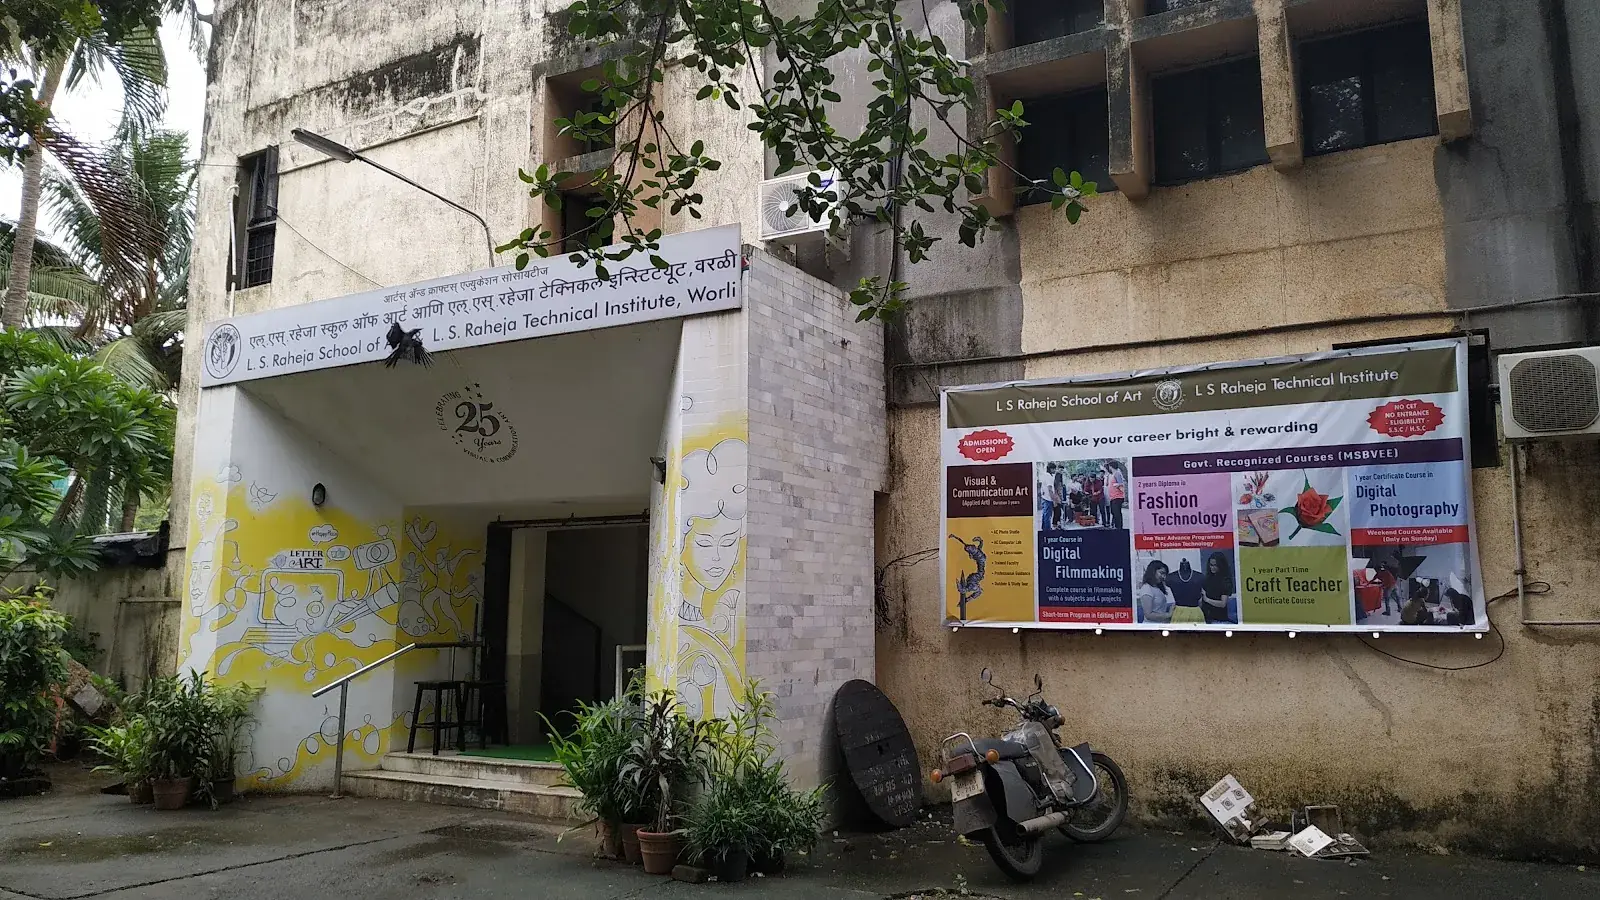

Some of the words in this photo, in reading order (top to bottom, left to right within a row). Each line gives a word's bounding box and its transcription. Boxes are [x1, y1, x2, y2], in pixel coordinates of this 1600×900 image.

[460, 276, 498, 291] एज्युकेशन
[320, 320, 348, 339] स्कुल
[352, 312, 379, 330] ऑफ
[382, 304, 407, 324] आर्ट
[412, 300, 444, 320] आणि
[539, 278, 604, 302] टेक्निकल
[247, 358, 256, 371] L.
[259, 356, 268, 369] S.
[272, 350, 314, 367] Raheja
[319, 340, 361, 360] School
[366, 336, 380, 352] of
[433, 328, 444, 342] L.
[448, 325, 460, 339] S.
[465, 318, 517, 338] Raheja
[522, 302, 598, 329] Technical
[605, 294, 681, 316] Institute,
[687, 282, 736, 304] Worli
[1195, 386, 1202, 396] L
[1206, 384, 1215, 395] S
[1221, 380, 1266, 396] Raheja
[1271, 375, 1334, 391] Technical
[1340, 368, 1399, 385] Institute
[996, 400, 1002, 412] L
[1006, 400, 1013, 411] S
[1018, 396, 1057, 412] Raheja
[1061, 393, 1102, 408] School
[1106, 392, 1118, 404] of
[1122, 390, 1142, 402] Art
[436, 391, 462, 431] CELEBRATING
[455, 401, 500, 436] 25
[497, 411, 510, 423] ART
[1396, 410, 1430, 418] ENTRANCE
[1053, 434, 1090, 448] Make
[1093, 435, 1122, 448] your
[1127, 432, 1171, 444] career
[1176, 426, 1219, 441] bright
[1224, 426, 1235, 437] &
[1240, 420, 1318, 436] rewarding
[474, 438, 502, 452] Years
[496, 426, 519, 463] COMMUNICATION
[963, 438, 1008, 448] ADMISSIONS
[976, 446, 996, 454] OPEN
[464, 448, 488, 462] VISUAL
[1184, 460, 1212, 469] Govt.
[1216, 454, 1282, 469] Recognized
[1286, 453, 1334, 464] Courses
[1338, 448, 1399, 461] (MSBVEE)
[964, 476, 988, 486] Visual
[990, 476, 996, 485] &
[1142, 481, 1157, 489] years
[1158, 480, 1180, 489] Diploma
[952, 487, 1014, 498] Communication
[1015, 486, 1028, 496] Art
[1138, 491, 1198, 509] Fashion
[1356, 484, 1396, 500] Digital
[1370, 502, 1459, 518] Photography
[1152, 511, 1227, 527] Technology
[1043, 546, 1081, 562] Digital
[1056, 565, 1124, 582] Filmmaking
[1046, 586, 1069, 594] Complete
[1094, 586, 1122, 594] filmmaking
[1246, 577, 1281, 592] Craft
[1285, 576, 1343, 592] Teacher
